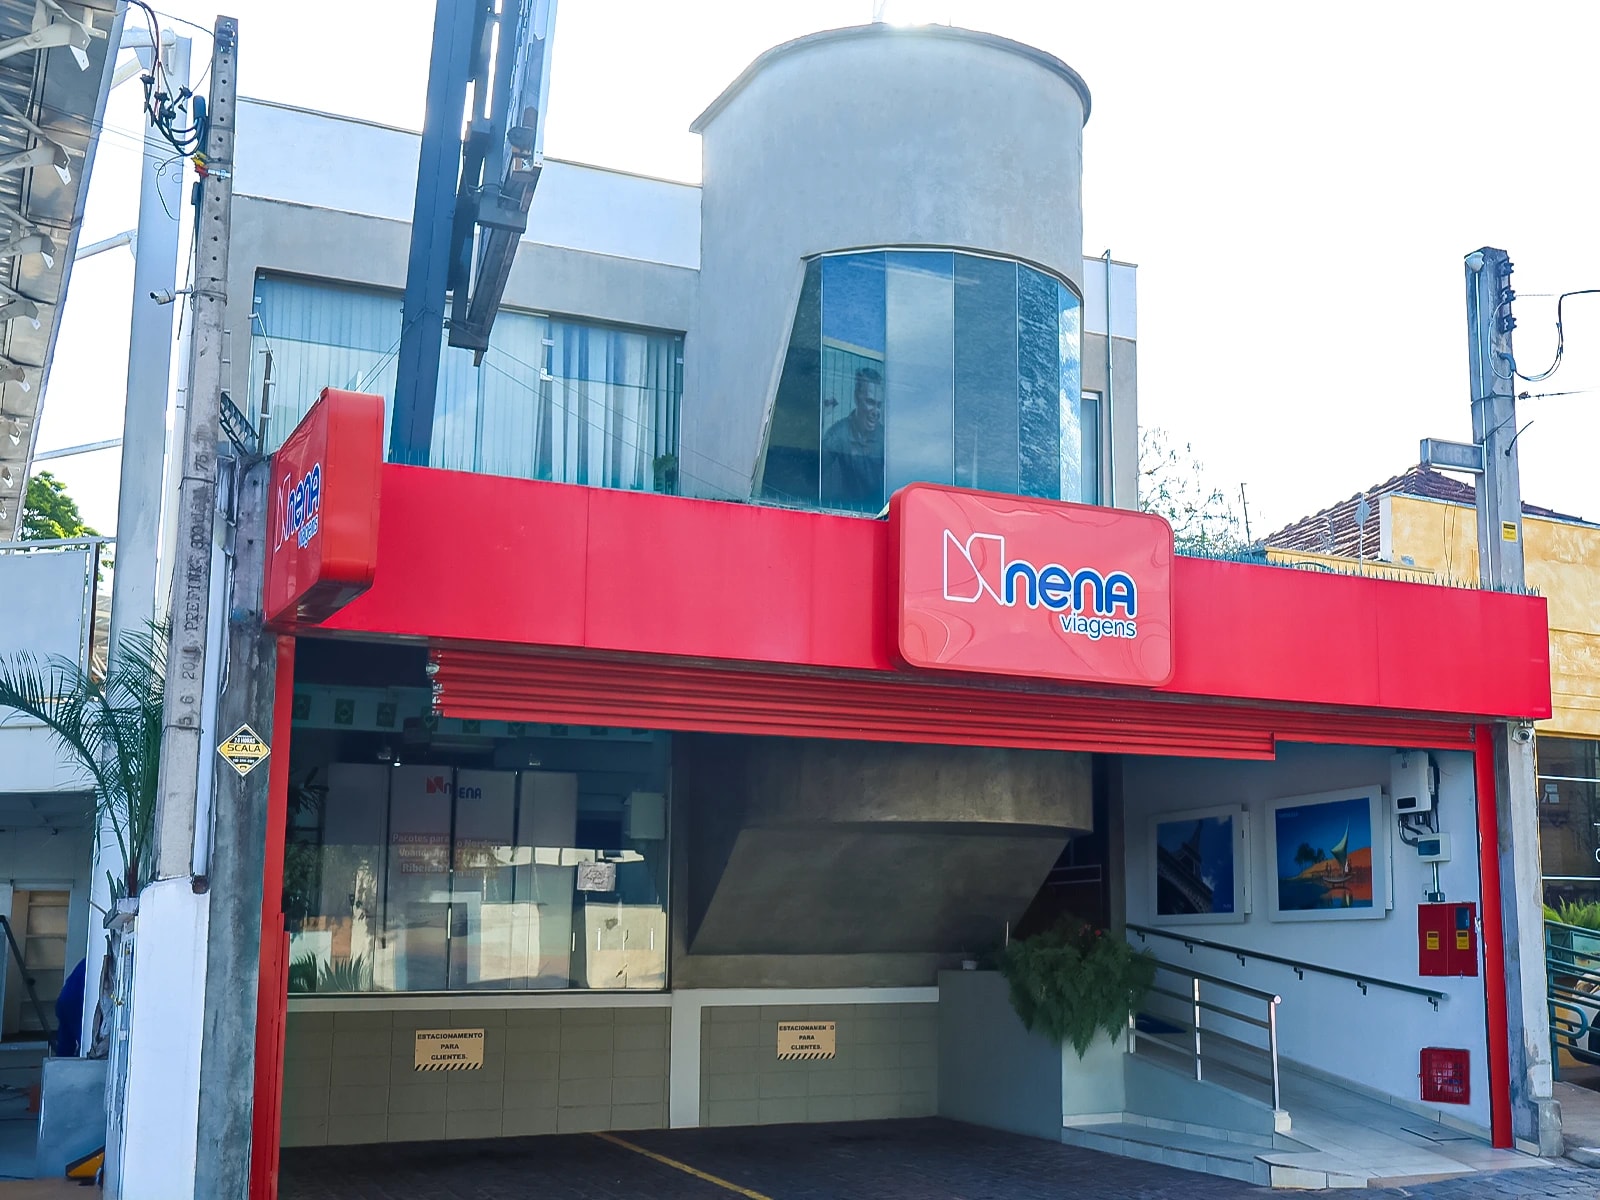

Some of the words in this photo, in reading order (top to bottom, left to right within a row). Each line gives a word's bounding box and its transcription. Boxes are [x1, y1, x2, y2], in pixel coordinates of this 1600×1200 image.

[1060, 612, 1138, 640] viagens
[227, 744, 261, 752] SCALA
[392, 833, 427, 843] Pacotes
[417, 1032, 483, 1040] ESTACIONAMENTO
